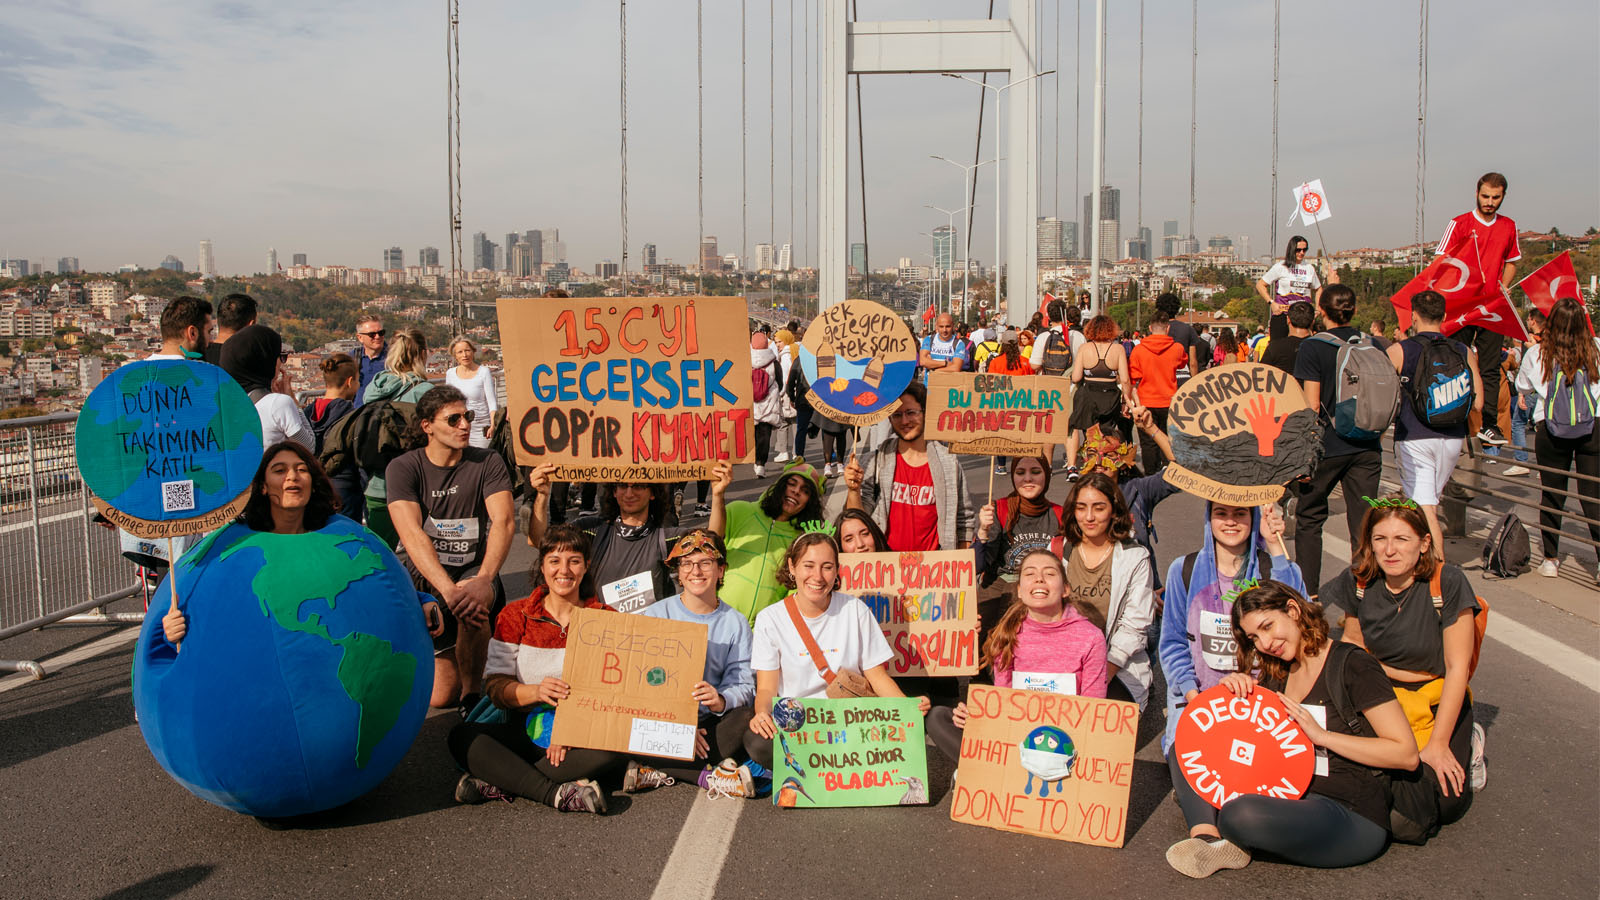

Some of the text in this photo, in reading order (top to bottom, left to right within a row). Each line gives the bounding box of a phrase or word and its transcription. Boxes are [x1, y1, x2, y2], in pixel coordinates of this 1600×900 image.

[822, 303, 854, 324] tek
[824, 313, 895, 344] gezegen
[123, 385, 192, 415] DÜNYA
[531, 358, 738, 409] GEÇERSEK
[948, 388, 1064, 411] BU HAVALAR
[1168, 367, 1287, 430] KÖMÜRDEN
[1433, 372, 1470, 409] NIKE
[519, 407, 623, 458] COP'AR
[1198, 402, 1247, 436] ÇIK
[116, 427, 221, 455] TAKIMINA
[146, 454, 203, 478] KATIL
[618, 594, 646, 613] 61775
[578, 619, 694, 660] GEZEGEN
[601, 652, 623, 685] B
[968, 688, 1136, 735] SO SORRY FOR
[808, 747, 906, 769] ONLAR DİYOR
[961, 737, 1131, 787] WHAT WE'VE
[952, 785, 1123, 843] DONE TO YOU
